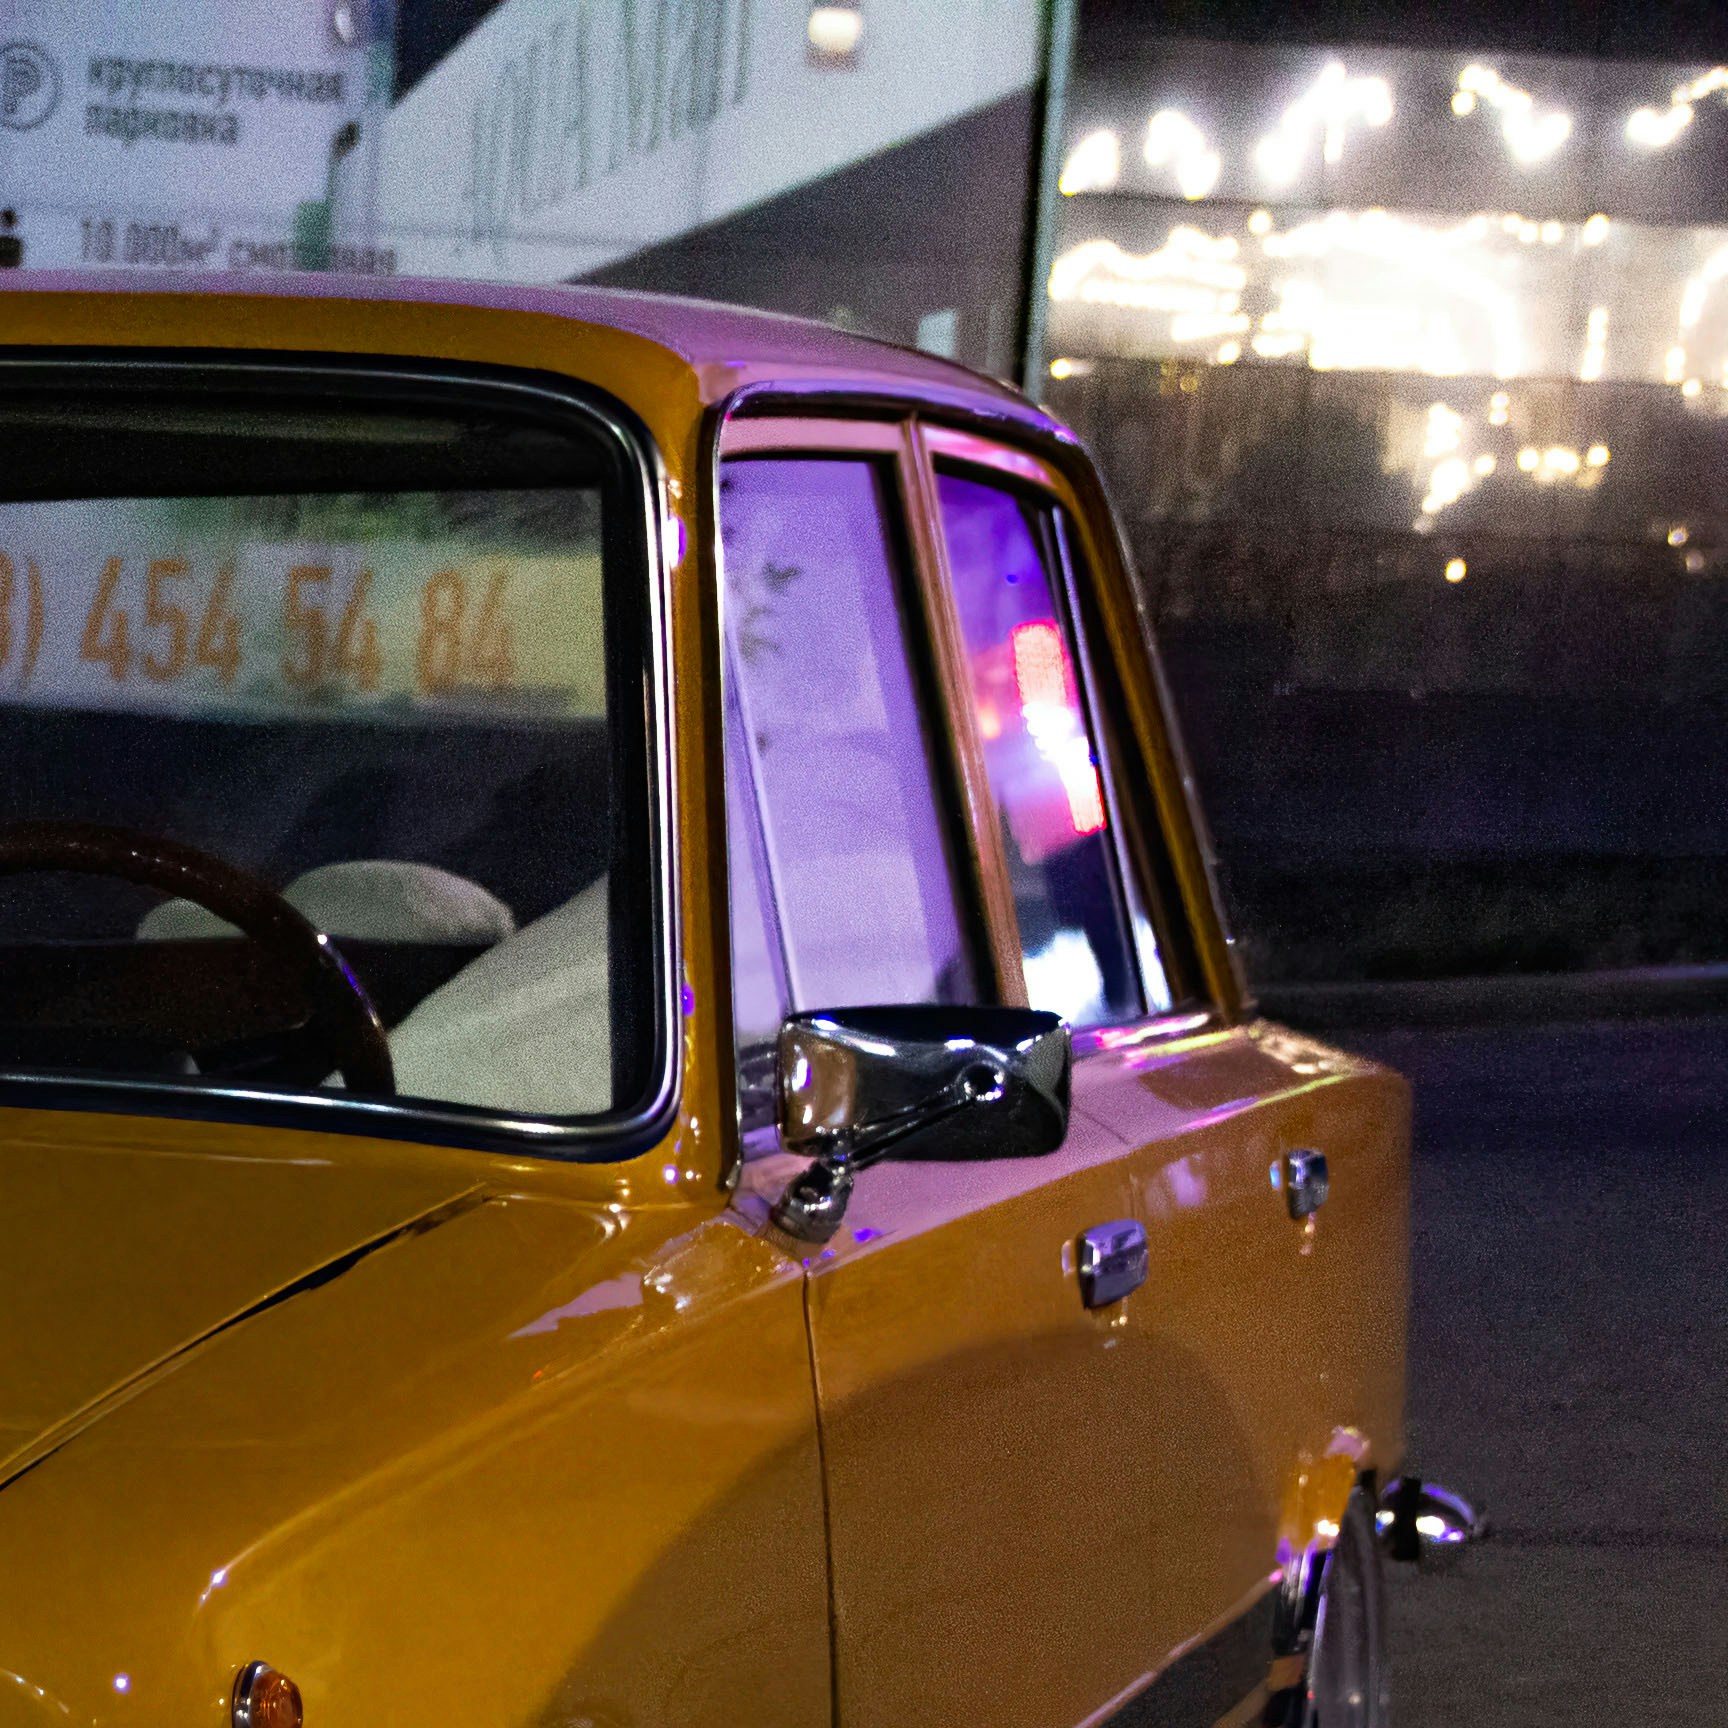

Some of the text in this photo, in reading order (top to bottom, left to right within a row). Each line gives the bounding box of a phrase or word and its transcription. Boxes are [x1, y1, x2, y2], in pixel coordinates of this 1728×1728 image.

[87, 56, 347, 111] круглосуточная
[84, 100, 239, 148] парковка
[80, 555, 243, 692] 454
[280, 563, 383, 693] 54
[415, 567, 517, 695] 84
